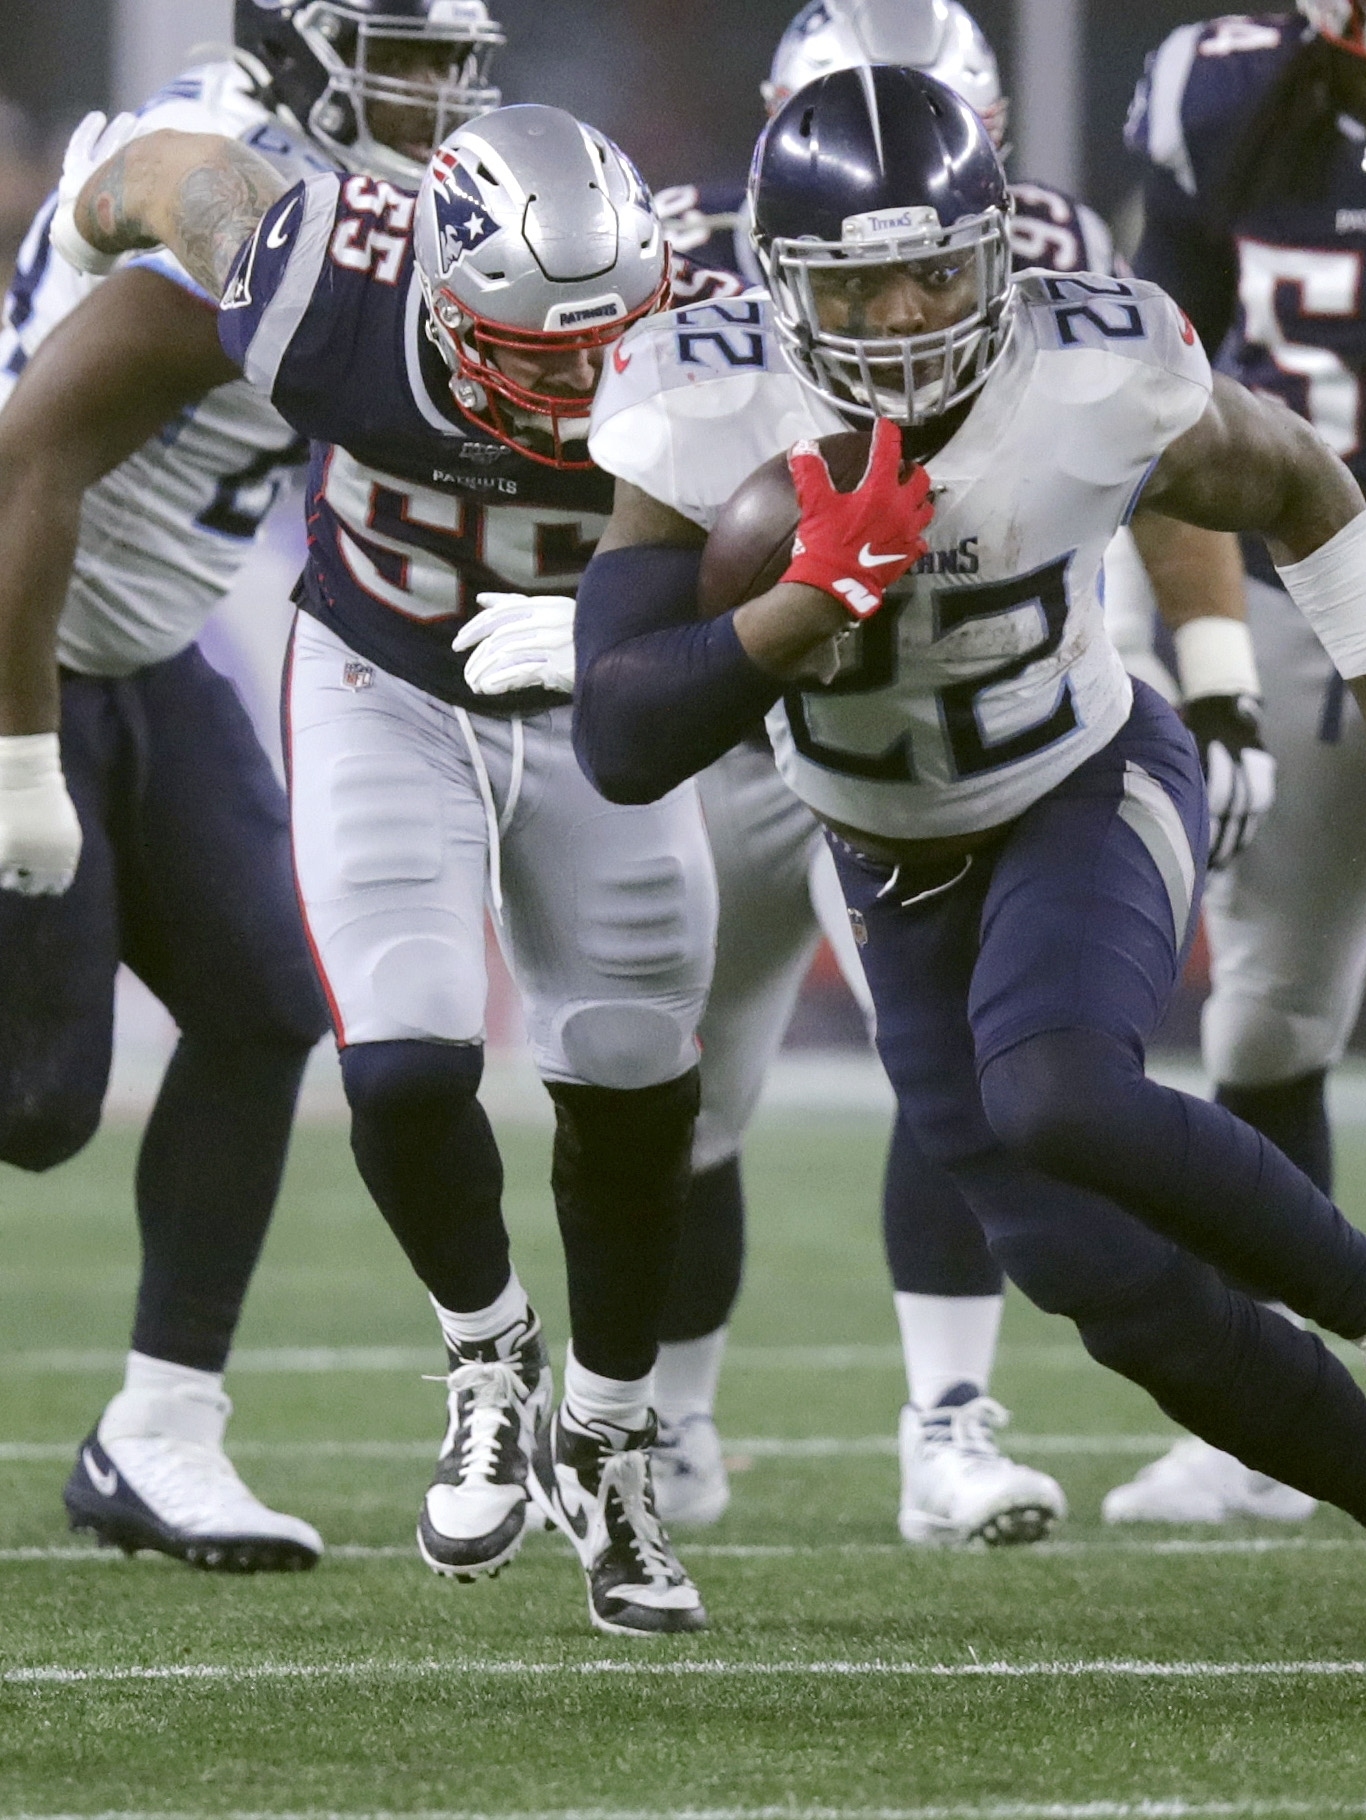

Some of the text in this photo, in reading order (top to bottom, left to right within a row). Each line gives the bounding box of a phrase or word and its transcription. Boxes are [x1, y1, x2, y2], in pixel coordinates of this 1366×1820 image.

[328, 174, 417, 286] 55
[676, 299, 770, 371] 22
[1041, 276, 1150, 348] 22
[778, 546, 1086, 785] 22
